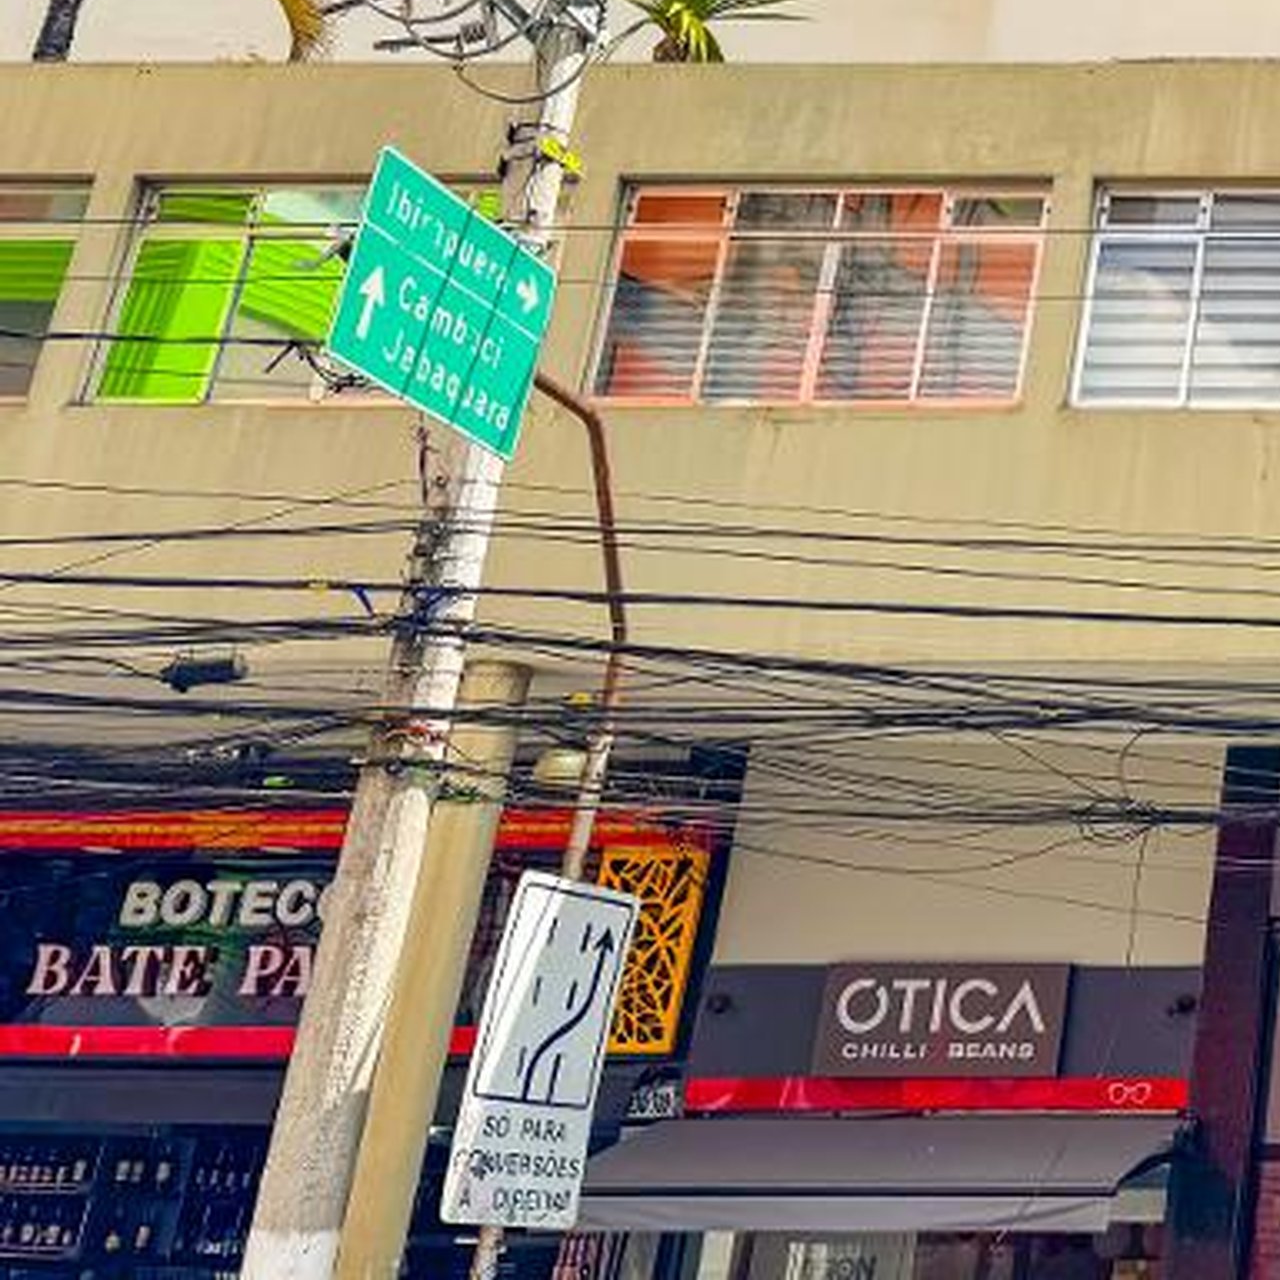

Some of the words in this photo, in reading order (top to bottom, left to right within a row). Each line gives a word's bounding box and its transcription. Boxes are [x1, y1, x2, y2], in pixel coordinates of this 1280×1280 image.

[119, 880, 332, 927] BOTEC
[26, 945, 207, 995] BATE
[841, 1042, 927, 1059] CHILLI
[948, 1042, 1035, 1059] BEANS
